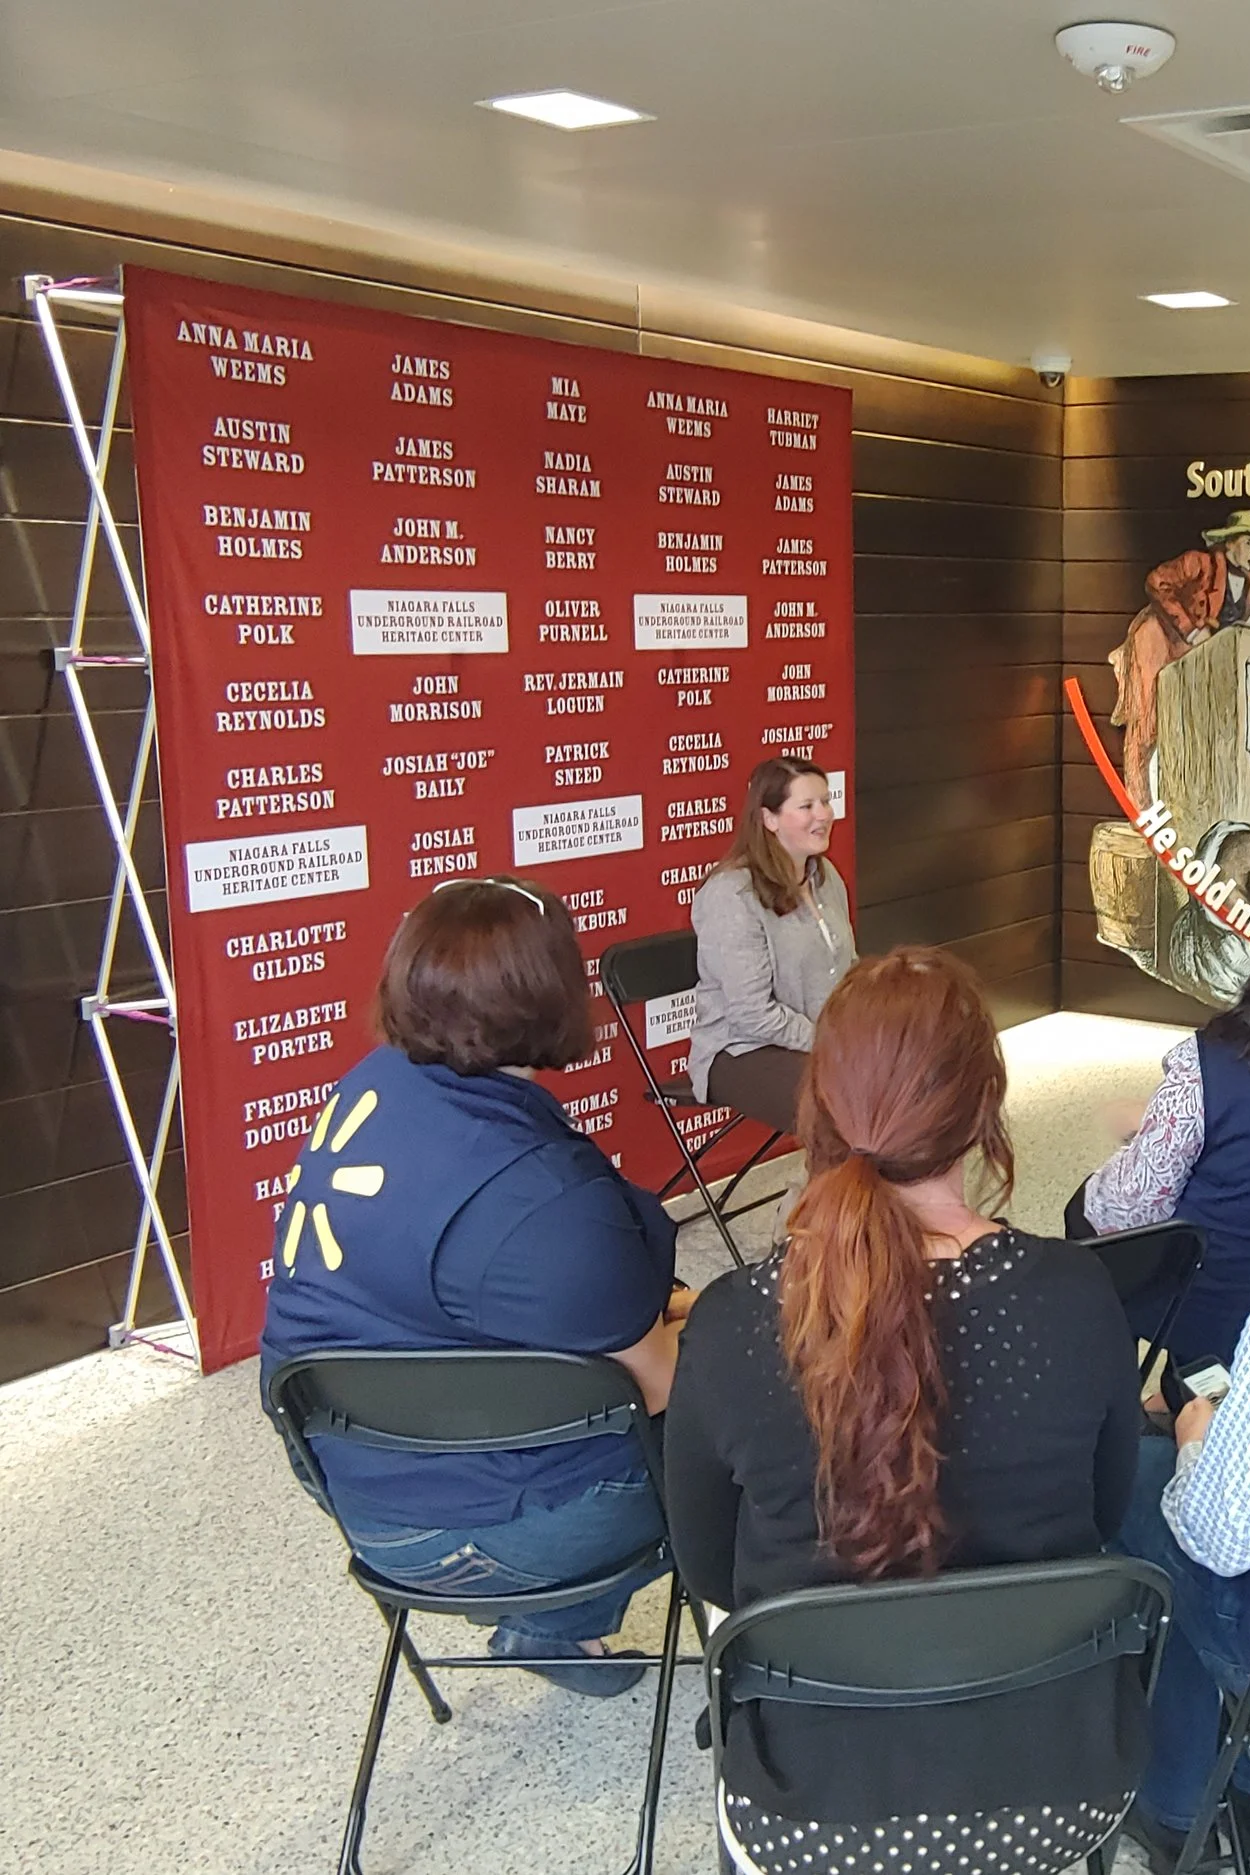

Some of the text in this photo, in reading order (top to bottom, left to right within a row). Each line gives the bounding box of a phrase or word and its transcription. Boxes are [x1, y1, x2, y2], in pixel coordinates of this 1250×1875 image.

[1126, 45, 1151, 57] FIRE
[177, 320, 314, 362] ANNA MARIA
[211, 356, 287, 386] WEEMS
[391, 354, 450, 380] JAMES
[390, 382, 454, 407] ADAMS
[552, 376, 580, 398] MIA
[547, 401, 587, 424] MAYE
[647, 391, 728, 418] ANNA MARIA
[666, 417, 712, 439] WEEMS
[767, 408, 820, 430] HARRIET
[214, 417, 291, 444] AUSTIN
[769, 430, 817, 451] TUBMAN
[395, 437, 453, 460] JAMES
[203, 445, 305, 475] STEWARD
[544, 451, 592, 473] NADIA
[372, 462, 476, 489] PATTERSON
[666, 463, 713, 484] AUSTIN
[775, 473, 812, 492] JAMES
[536, 476, 601, 498] SHARAM
[659, 486, 721, 507] STEWARD
[775, 495, 814, 514] ADAMS
[204, 504, 312, 532] BENJAMIN
[393, 518, 465, 540] JOHN M.
[545, 526, 595, 546] NANCY
[658, 532, 723, 552] BENJAMIN
[776, 538, 813, 555] JAMES
[218, 536, 303, 560] HOLMES
[381, 545, 477, 567] ANDERSON
[546, 551, 596, 570] BERRY
[665, 555, 717, 574] HOLMES
[762, 559, 827, 577] PATTERSON
[205, 595, 323, 617] CATHERINE
[387, 600, 475, 614] NIAGARA FALLS
[545, 600, 601, 618] OLIVER
[660, 603, 724, 614] NIAGARA FALLS
[773, 601, 804, 619] JOHN
[357, 615, 504, 629] UNDERGROUND RAILROAD
[638, 616, 745, 627] UNDERGROUND RAILROAD
[765, 623, 826, 639] ANDERSON
[238, 625, 295, 645] POLK
[382, 630, 484, 643] HERITAGE CENTER
[539, 624, 608, 642] PURNELL
[655, 628, 730, 640] HERITAGE CENTER
[524, 670, 624, 692] REV. JERMAIN
[657, 666, 730, 686] CATHERINE
[781, 663, 812, 680] JOHN
[226, 681, 314, 703] CECELIA
[413, 675, 459, 695] JOHN
[766, 684, 826, 702] MORRISON
[547, 695, 605, 716] LOGUEN
[677, 689, 712, 707] POLK
[216, 708, 326, 733] REYNOLDS
[390, 700, 482, 723] MORRISON
[669, 733, 722, 752] CECELIA
[761, 726, 803, 744] JOSIAH
[383, 752, 448, 776] JOSIAH
[545, 742, 609, 764] PATRICK
[662, 754, 729, 775] REYNOLDS
[227, 763, 324, 789] CHARLES
[555, 766, 602, 787] SNEED
[415, 777, 466, 800] BAILY
[216, 789, 336, 820] PATTERSON
[543, 806, 616, 825] NIAGARA FALLS
[667, 797, 727, 819] CHARLES
[411, 826, 475, 852] JOSIAH
[518, 816, 639, 842] UNDERGROUND RAILROAD
[661, 817, 734, 842] PATTERSON
[228, 839, 331, 863] NIAGARA FALLS
[537, 833, 623, 853] HERITAGE CENTER
[410, 851, 478, 878] HENSON
[1136, 799, 1178, 854] He
[1168, 845, 1237, 911] sold
[194, 850, 363, 883] UNDERGROUND RAILROAD
[661, 862, 720, 886] CHARLO
[222, 869, 340, 896] HERITAGE CENTER
[574, 908, 627, 932] KBURN
[226, 920, 347, 959] CHARLOTTE
[252, 951, 326, 982] GILDES
[671, 995, 695, 1009] NIAGA
[235, 1000, 348, 1042] ELIZABETH
[650, 1007, 697, 1026] UNDERGRO
[253, 1030, 334, 1065] PORTER
[244, 1080, 339, 1122] FREDRIC
[245, 1112, 321, 1149] DOUGL
